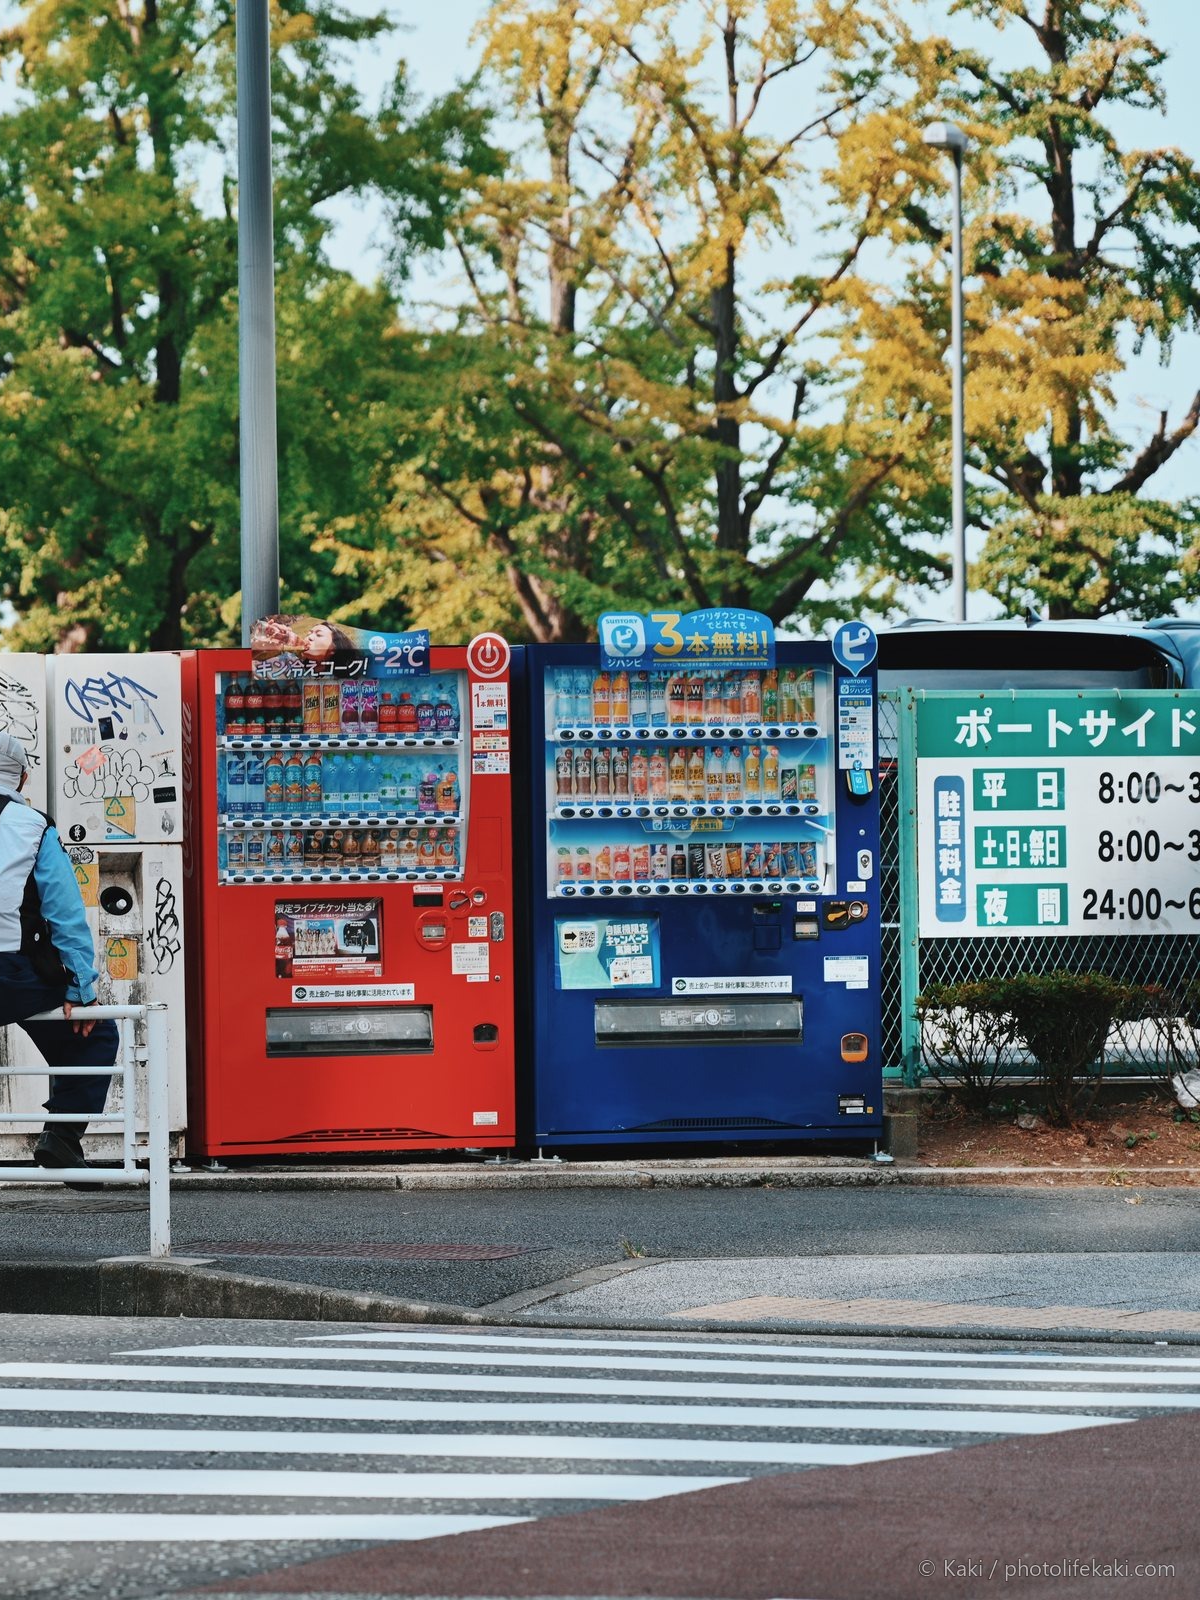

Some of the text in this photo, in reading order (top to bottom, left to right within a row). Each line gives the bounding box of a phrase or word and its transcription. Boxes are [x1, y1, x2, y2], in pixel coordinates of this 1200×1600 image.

[690, 611, 760, 624] アプリダウンロード
[706, 620, 747, 630] でどれでも
[256, 656, 369, 678] キン冷えコーク!
[607, 658, 642, 668] ジハンピ
[954, 707, 1198, 748] ポートサイド
[70, 726, 97, 745] KENT
[938, 789, 962, 905] 駐車料金
[275, 902, 375, 914] 限定ライブチケット当たる!
[983, 887, 1061, 925] 夜間
[606, 934, 649, 946] キャンペーン
[689, 981, 724, 990] 売上金の一部は
[309, 988, 412, 998] 売上金の一部は 緑化事業に活用されています。
